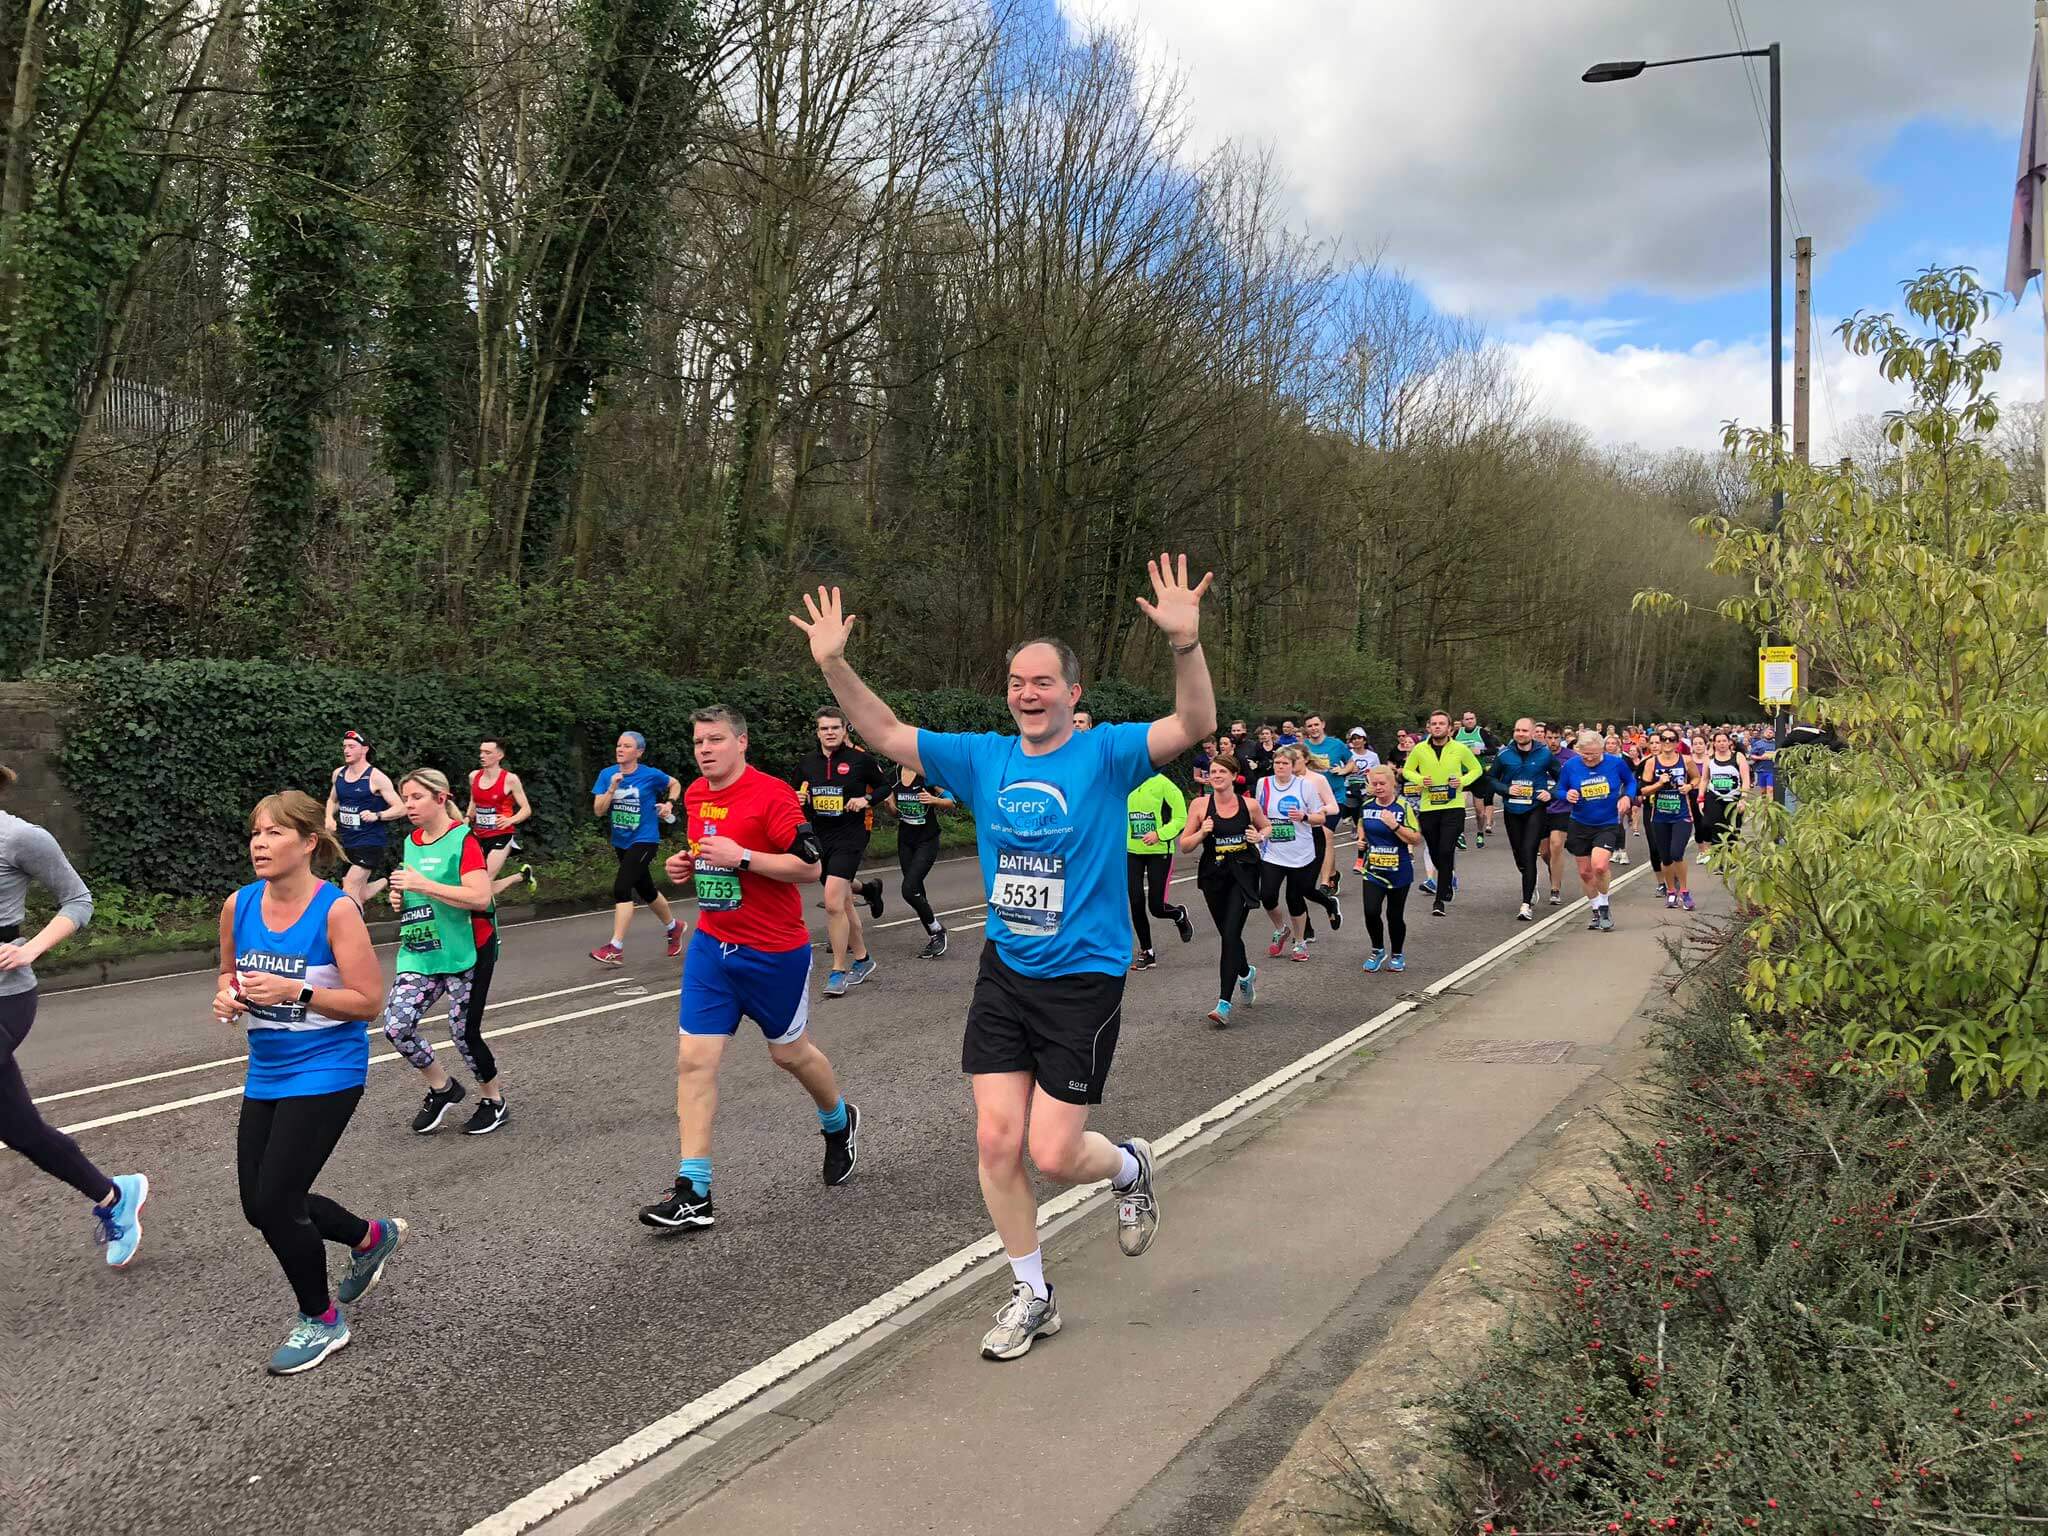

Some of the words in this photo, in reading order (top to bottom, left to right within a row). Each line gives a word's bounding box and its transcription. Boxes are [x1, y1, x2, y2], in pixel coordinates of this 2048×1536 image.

[815, 799, 840, 810] 14851
[999, 854, 1063, 873] BATHALF
[699, 880, 734, 899] 6753
[1002, 883, 1049, 909] 5531
